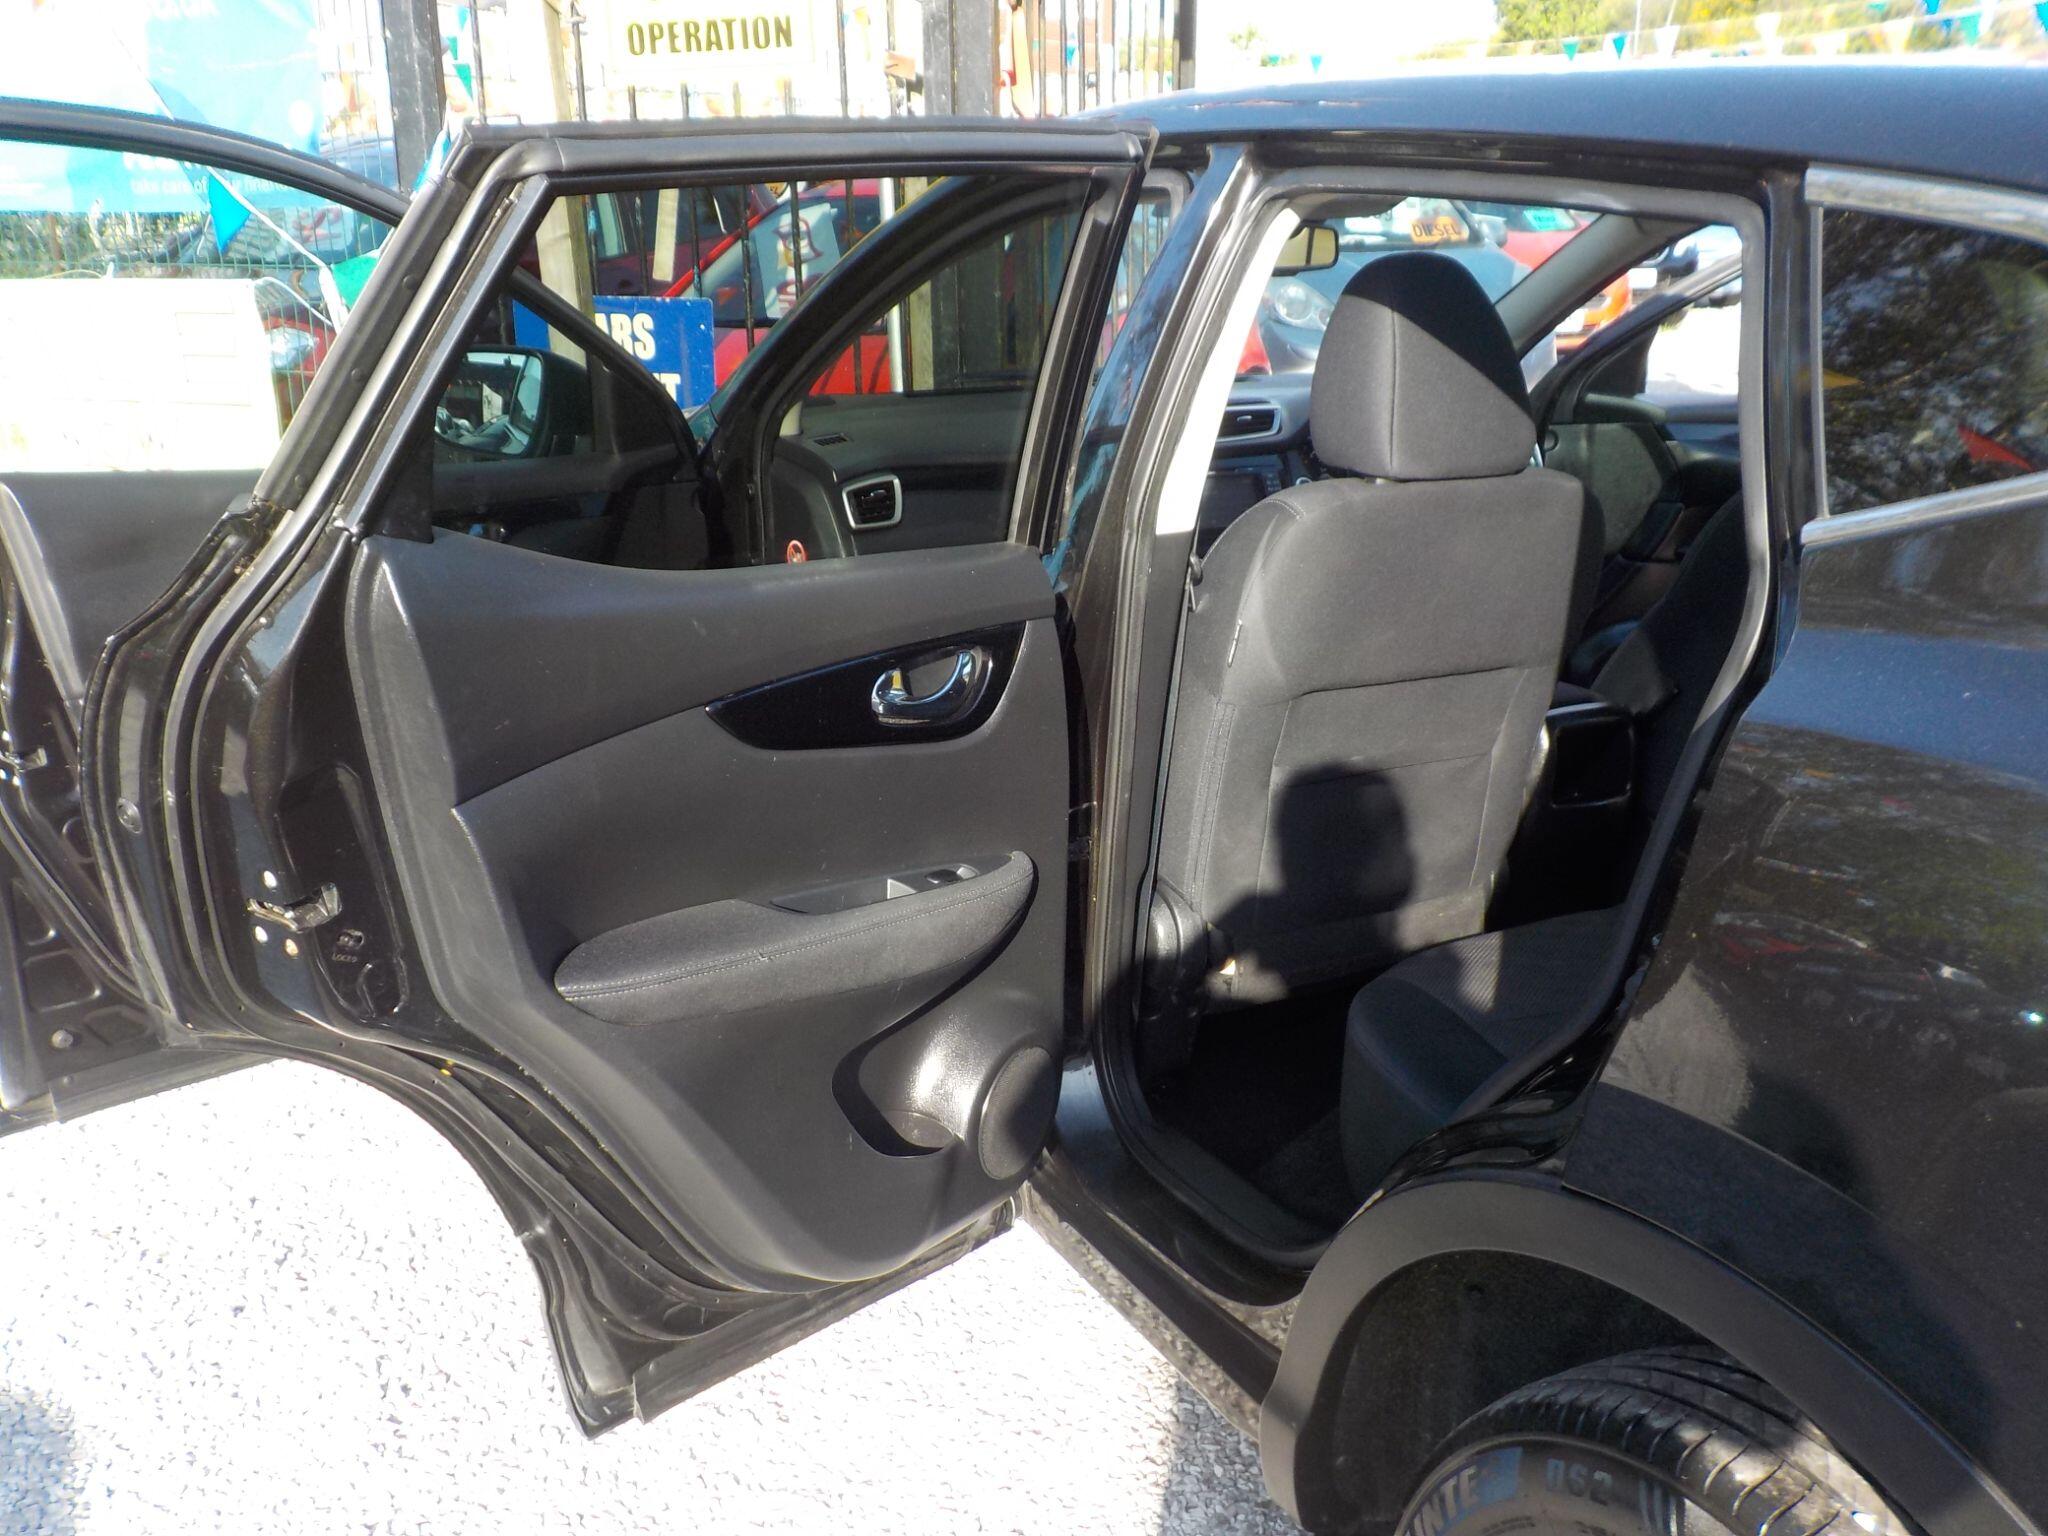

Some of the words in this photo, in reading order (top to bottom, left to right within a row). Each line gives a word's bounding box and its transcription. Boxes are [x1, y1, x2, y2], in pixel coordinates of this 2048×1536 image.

[626, 15, 793, 56] OPERATION
[1412, 222, 1462, 238] DIESEL
[1405, 1464, 1481, 1536] INTE
